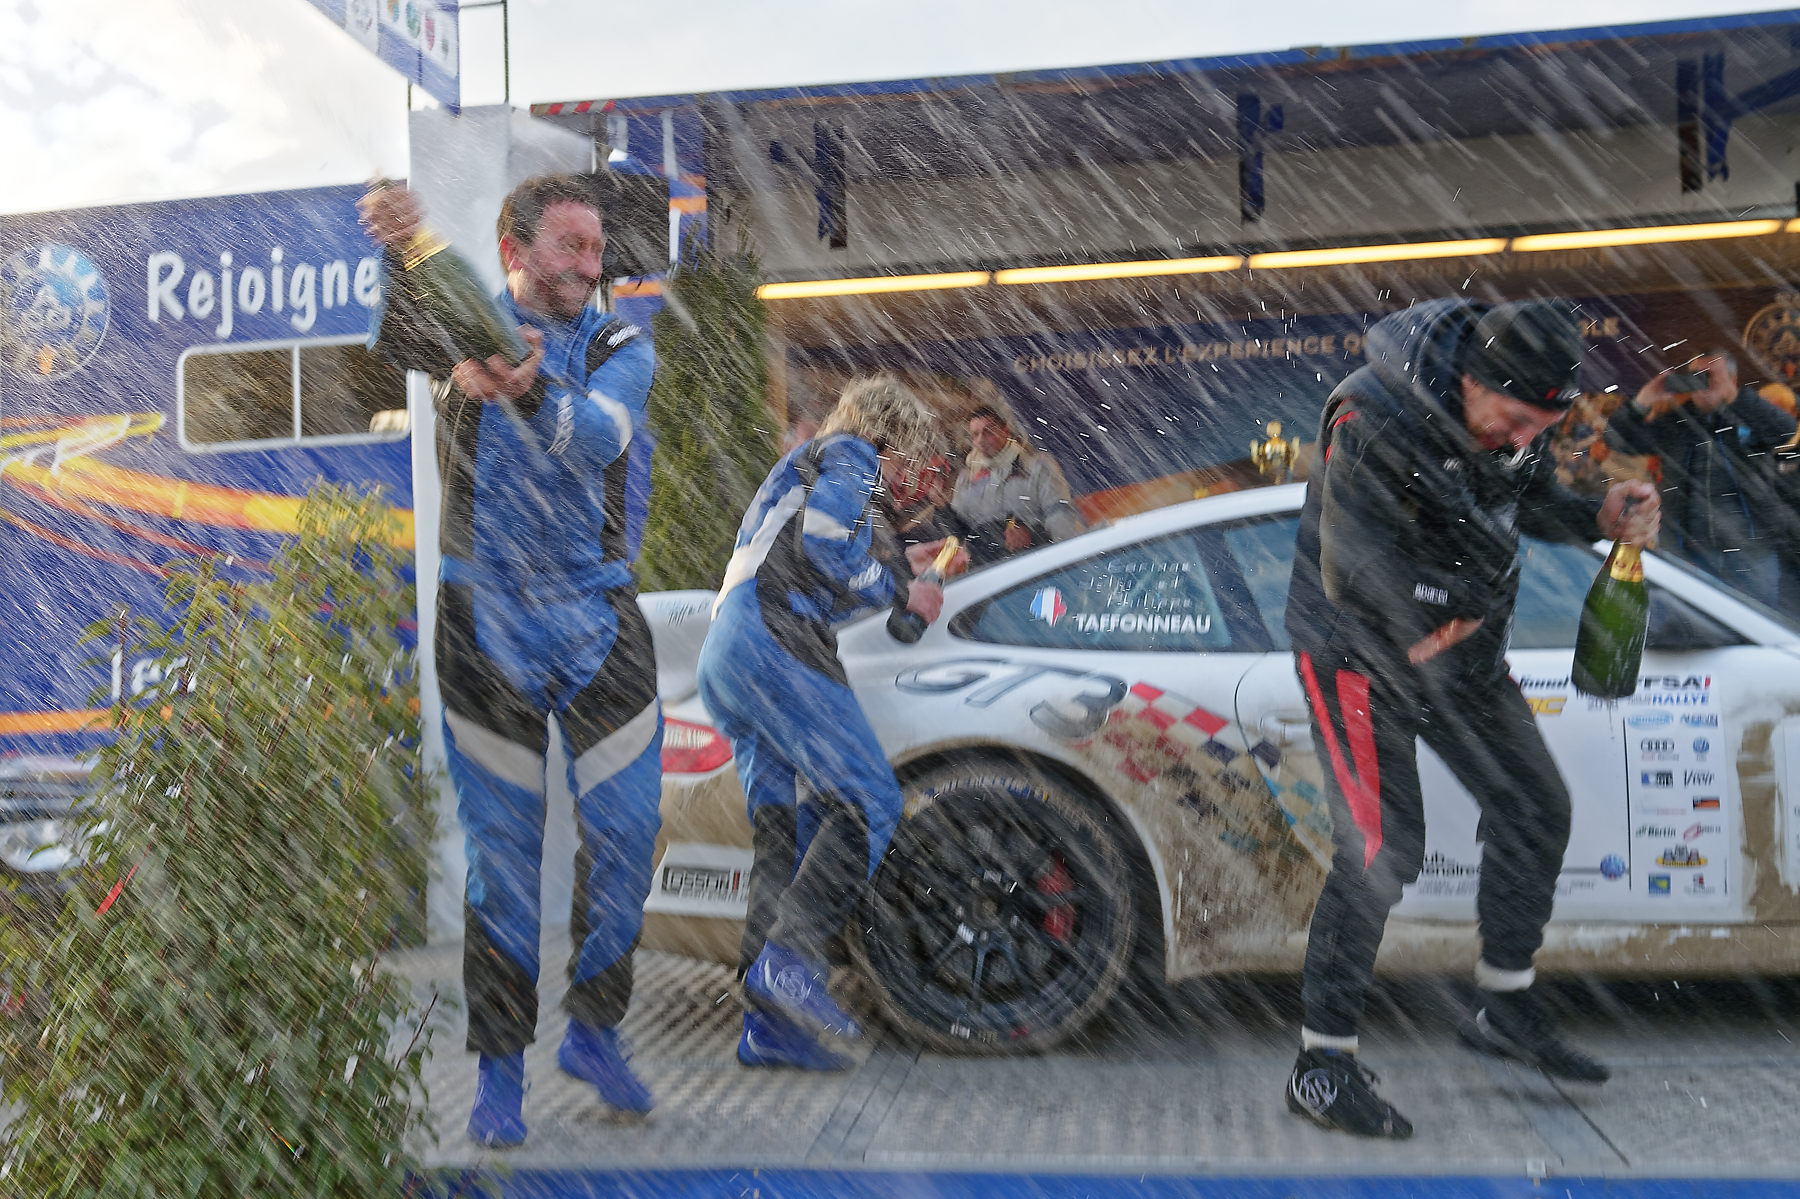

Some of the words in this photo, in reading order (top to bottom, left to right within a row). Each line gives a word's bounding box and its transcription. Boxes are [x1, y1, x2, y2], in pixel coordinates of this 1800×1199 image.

[1076, 612, 1211, 634] TAFFONNEAU
[1637, 675, 1700, 690] FSA
[1652, 692, 1710, 706] RALLYE
